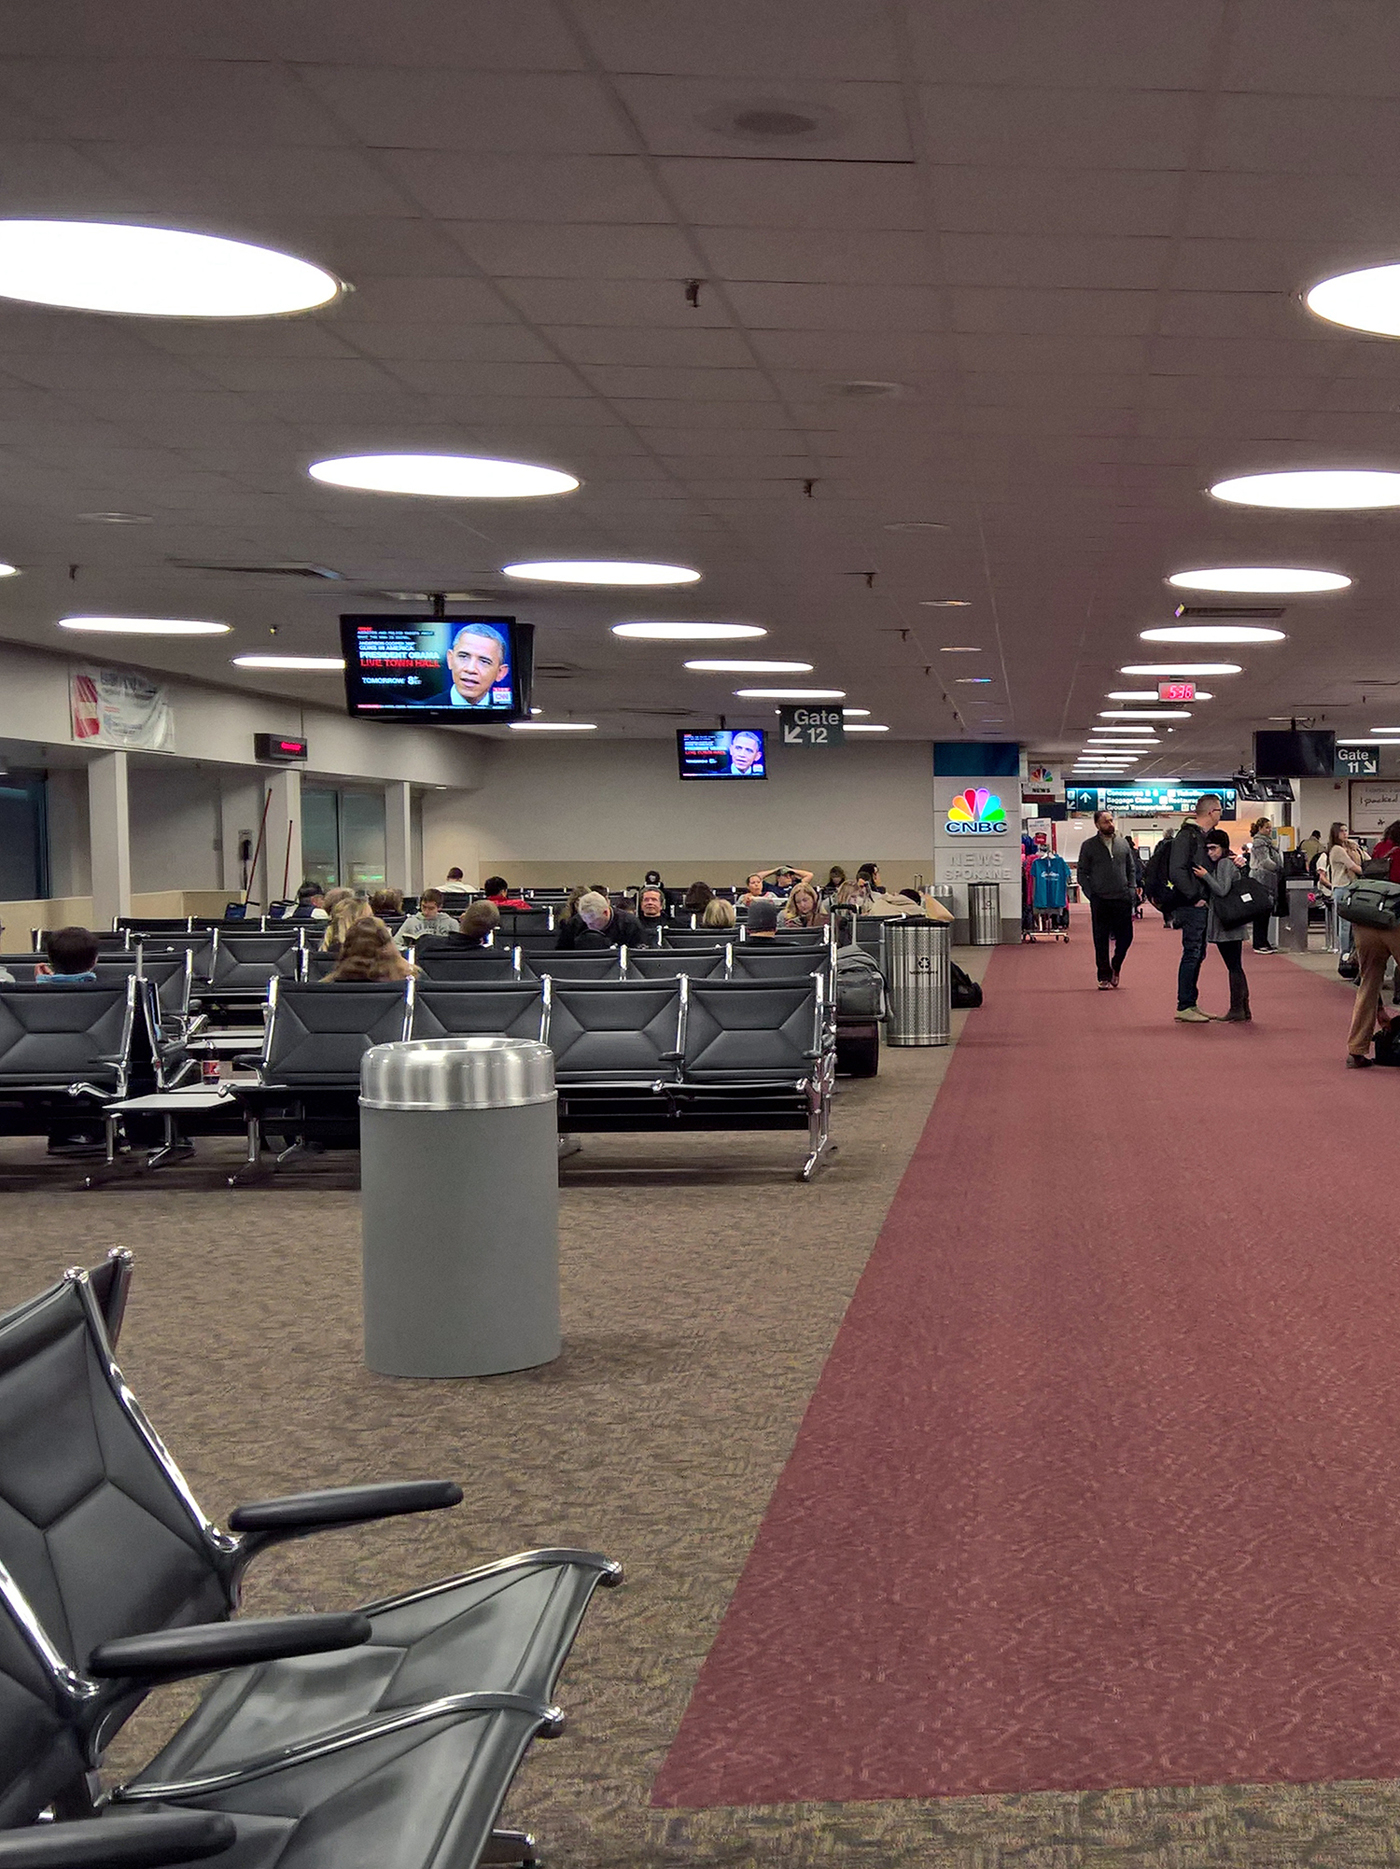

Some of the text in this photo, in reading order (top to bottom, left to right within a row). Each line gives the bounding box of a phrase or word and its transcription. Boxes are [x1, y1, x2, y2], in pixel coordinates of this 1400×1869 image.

[359, 651, 440, 659] PRESIDENT OBAMA
[360, 659, 440, 668] LIVE TOWN HALL
[1170, 685, 1192, 699] 5:36
[794, 709, 839, 725] Gate
[807, 727, 828, 743] 12
[1338, 749, 1369, 760] Gate
[1347, 761, 1359, 773] 11
[1364, 793, 1398, 807] packed
[1130, 804, 1174, 812] Transportation
[945, 821, 1008, 834] CNBC
[949, 851, 1003, 867] NEWS
[945, 868, 1011, 880] SPOKANE
